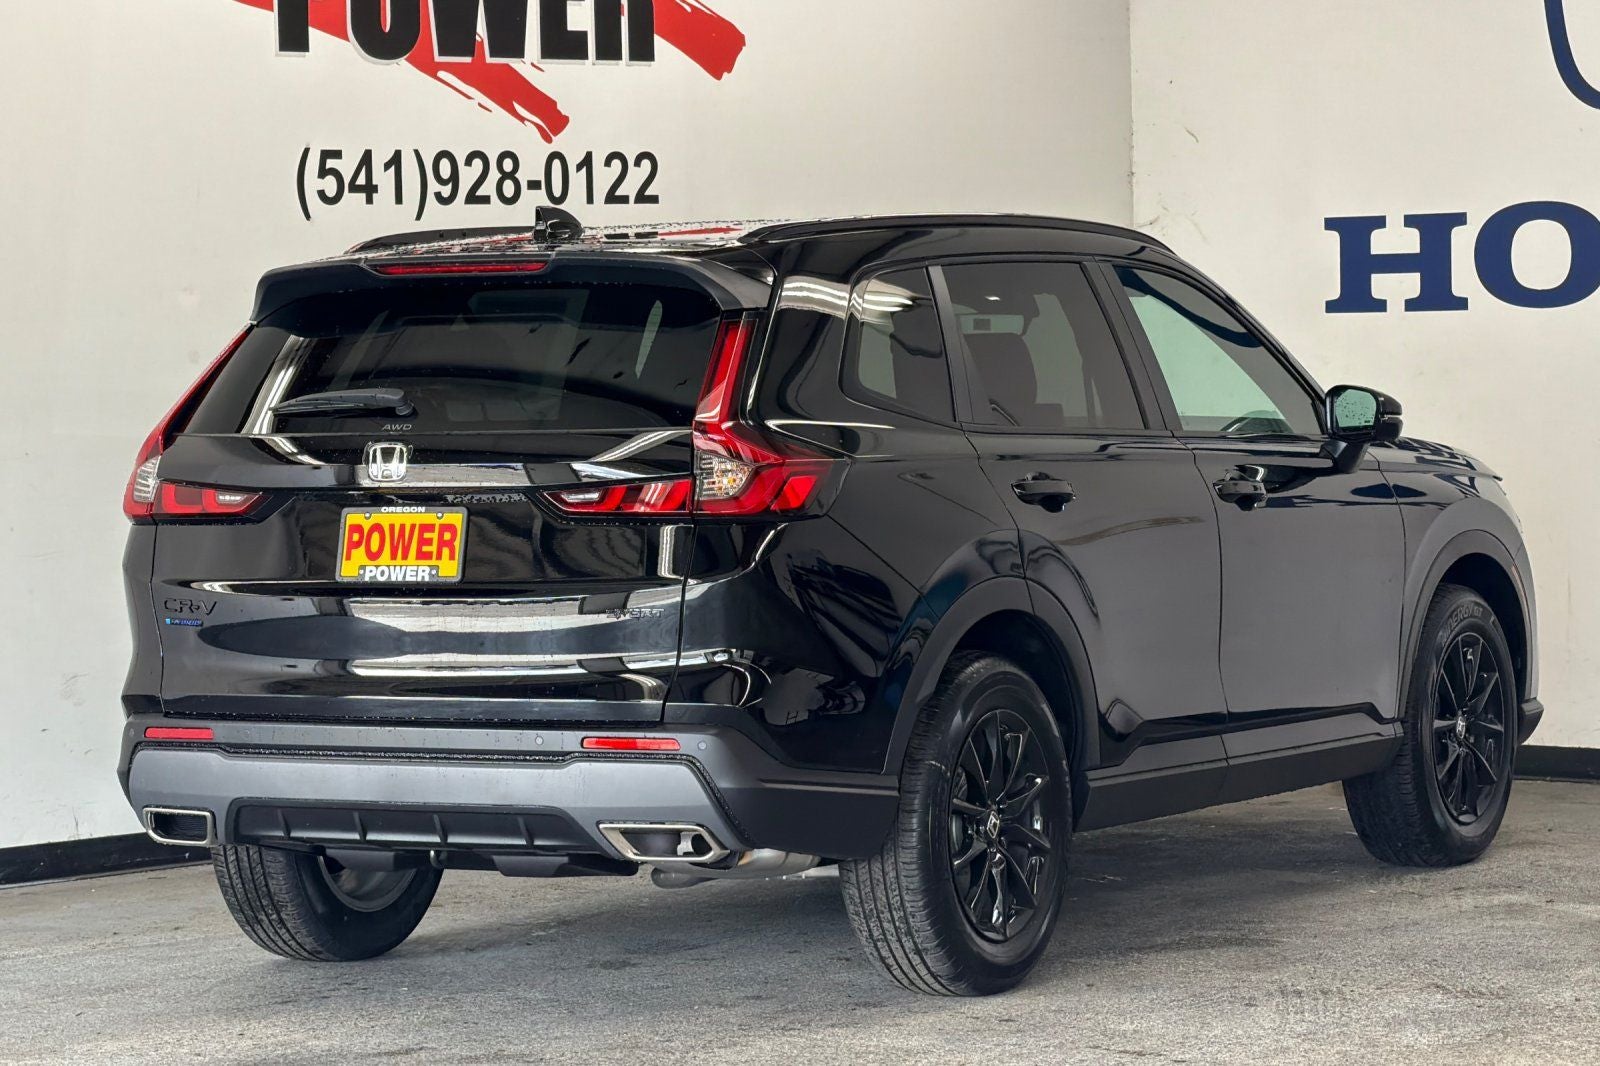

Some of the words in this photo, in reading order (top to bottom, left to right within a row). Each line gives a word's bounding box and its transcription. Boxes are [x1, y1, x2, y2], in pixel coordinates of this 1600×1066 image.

[296, 147, 660, 220] (541)928-0122
[382, 423, 412, 431] AWD
[344, 522, 458, 562] POWER
[364, 565, 431, 582] POWER
